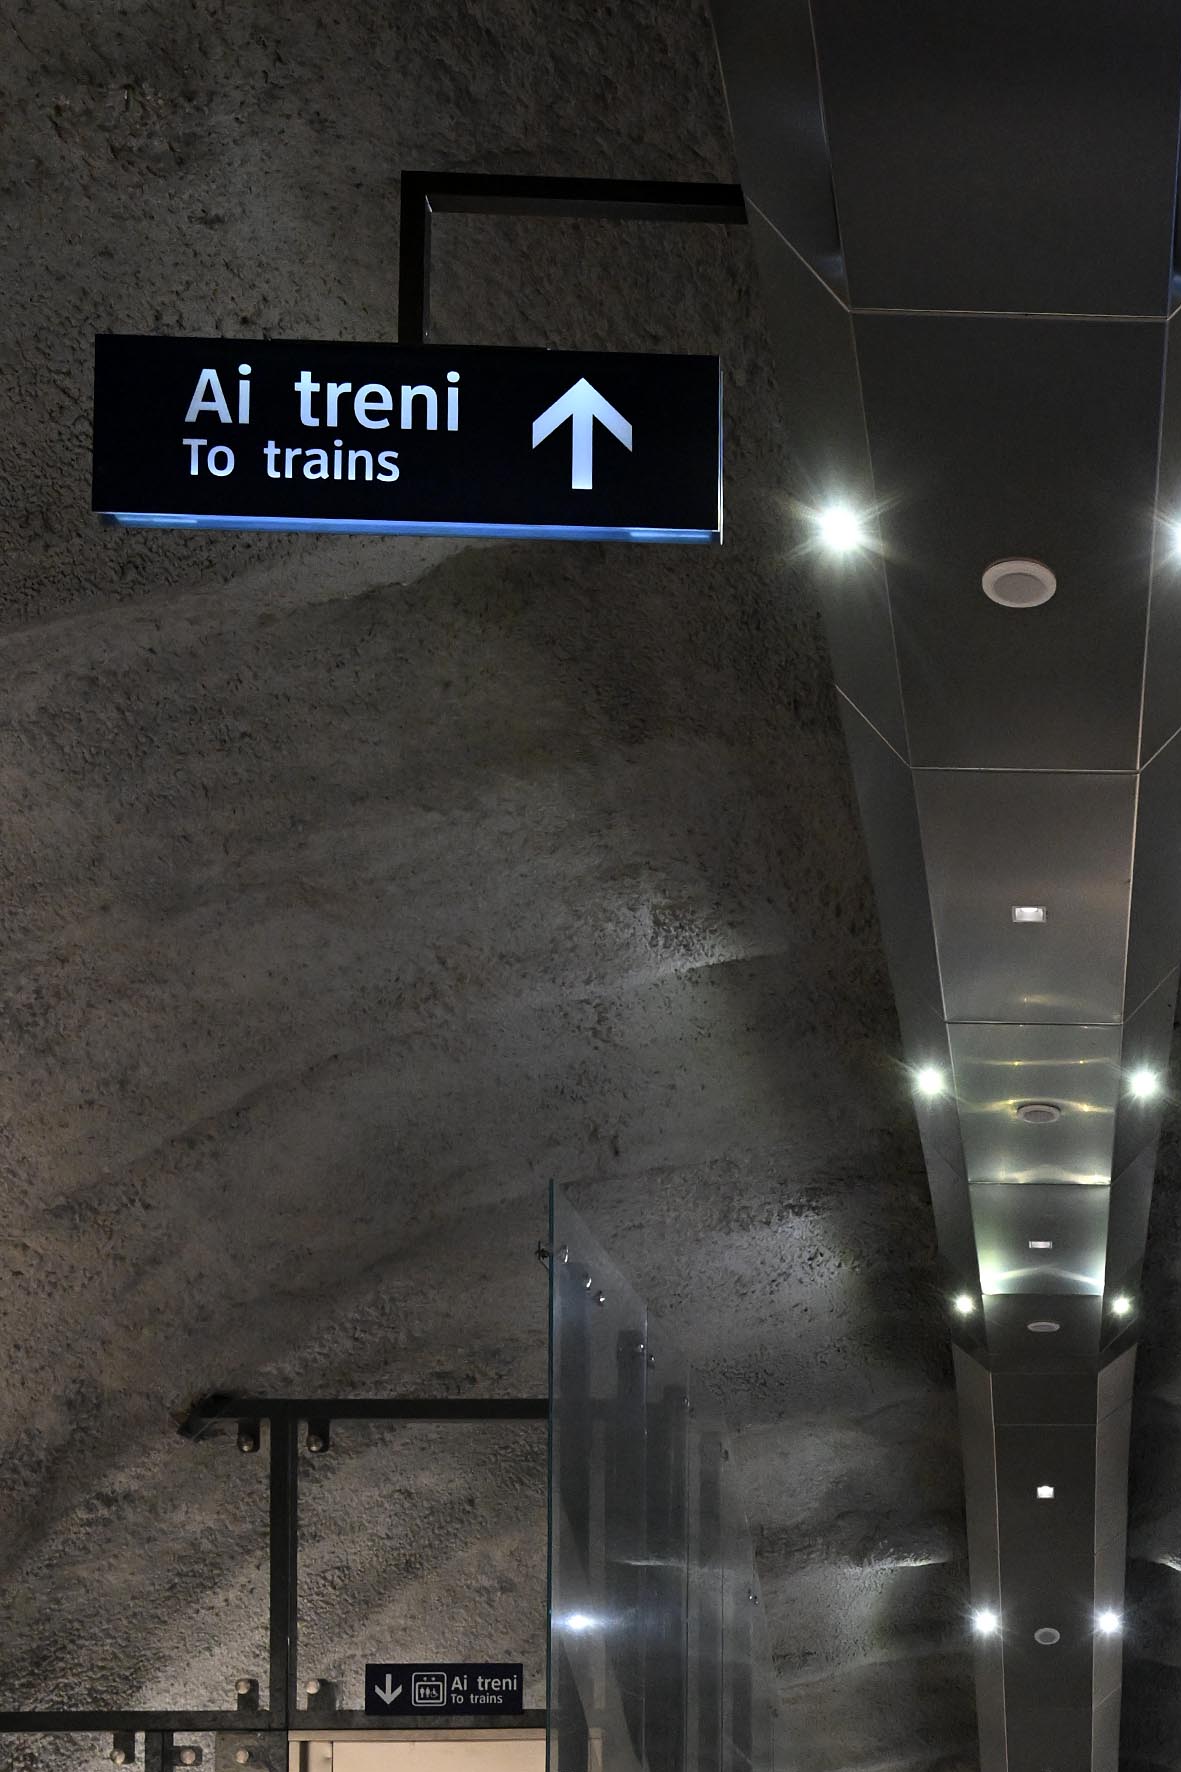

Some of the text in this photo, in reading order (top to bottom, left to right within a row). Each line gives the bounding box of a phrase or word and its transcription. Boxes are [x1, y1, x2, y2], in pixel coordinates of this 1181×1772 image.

[183, 363, 461, 433] Ai treni
[182, 438, 400, 483] To trains
[450, 1692, 503, 1704] To trains
[451, 1674, 517, 1691] Ai treni
